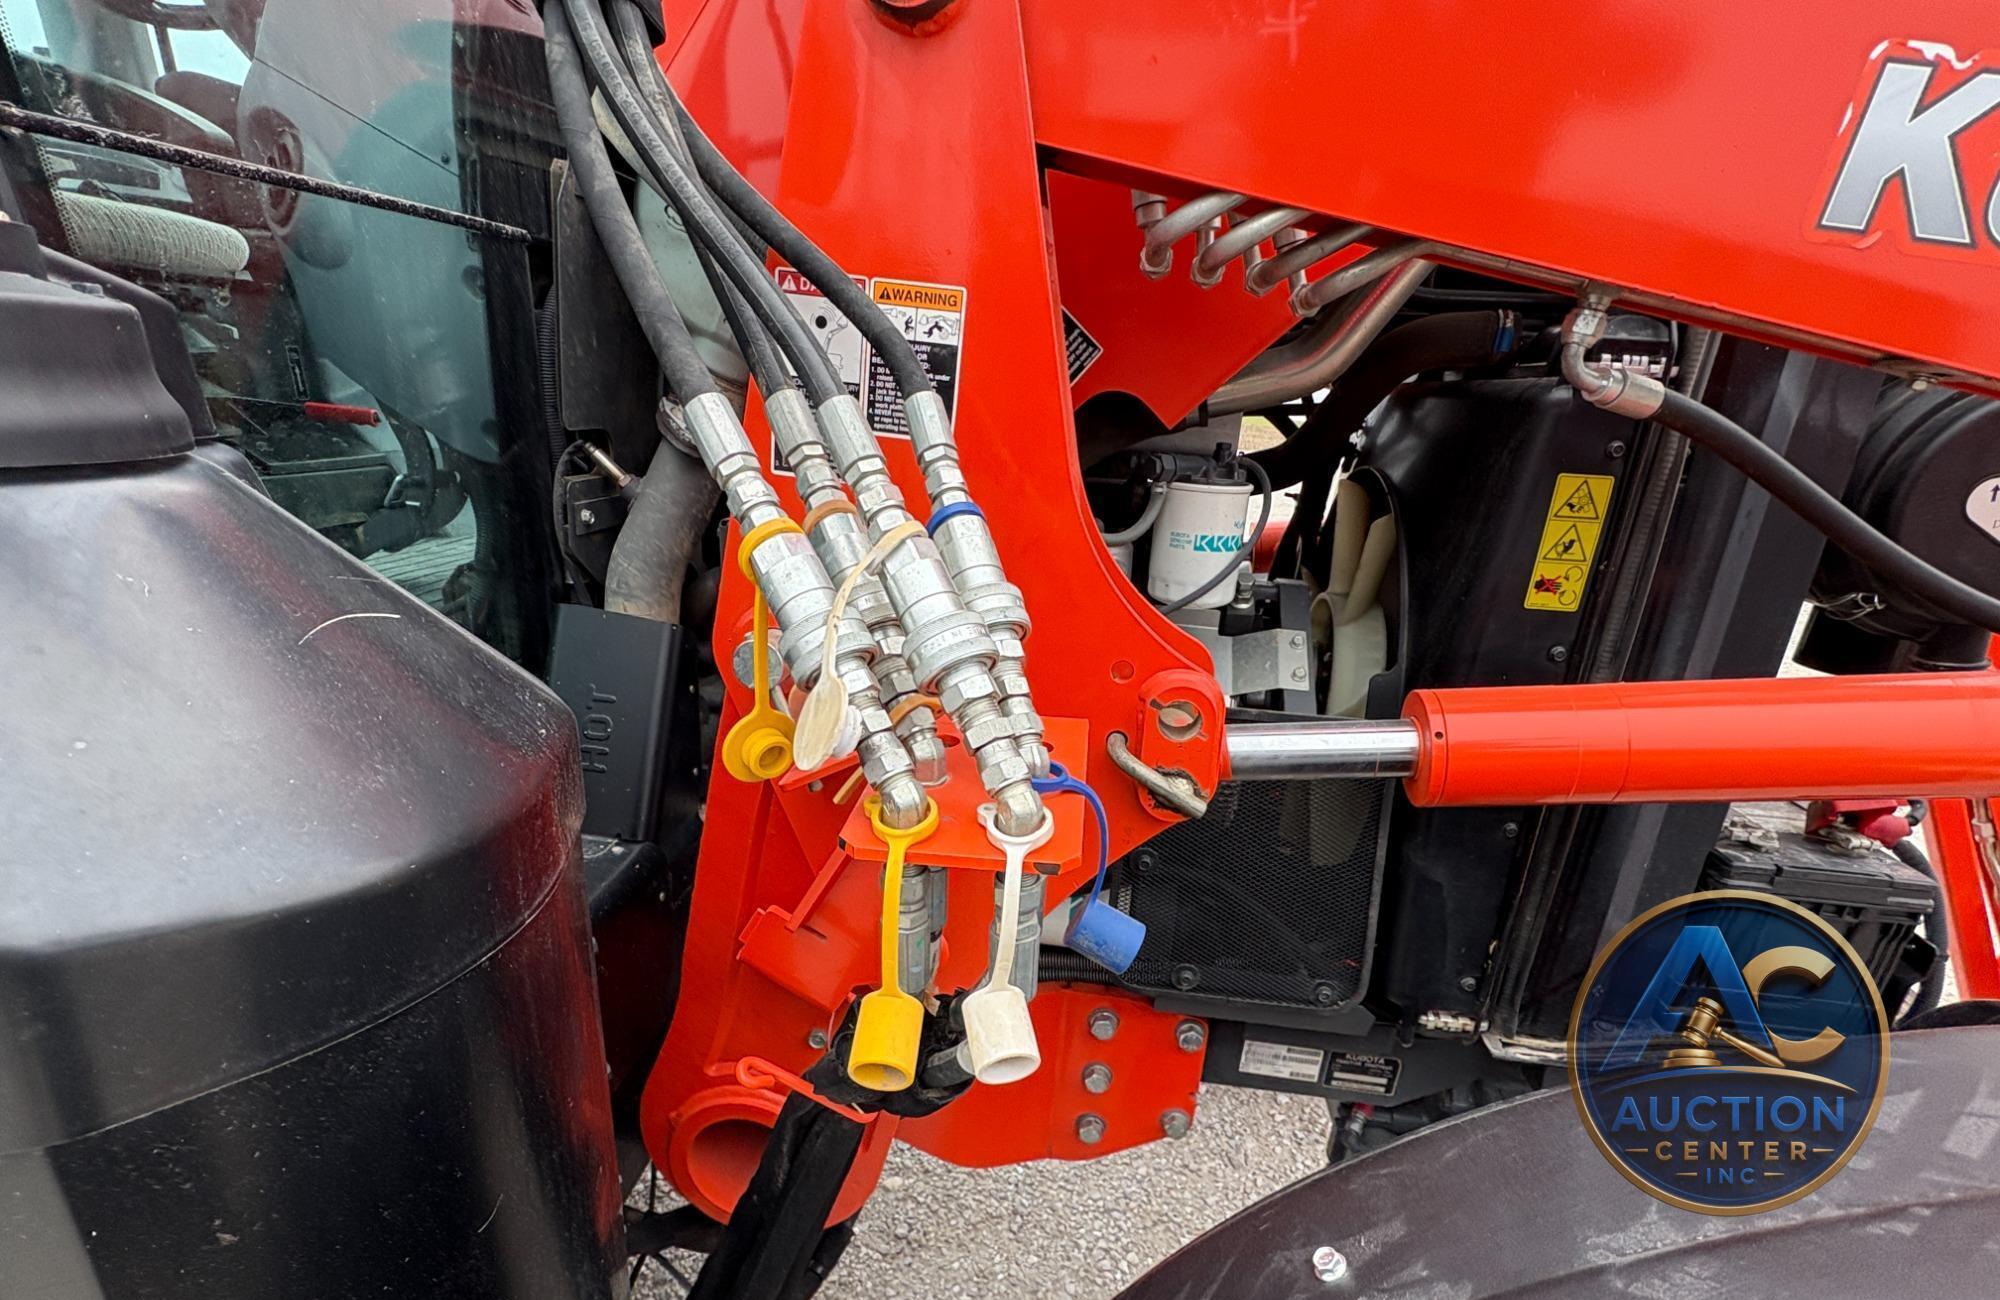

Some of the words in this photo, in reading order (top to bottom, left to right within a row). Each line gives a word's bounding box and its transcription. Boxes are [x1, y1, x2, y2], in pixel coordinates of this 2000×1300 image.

[1816, 56, 2000, 251] K
[892, 288, 958, 307] WARNING
[581, 683, 617, 774] HOT
[1345, 1053, 1386, 1065] KUBOTA
